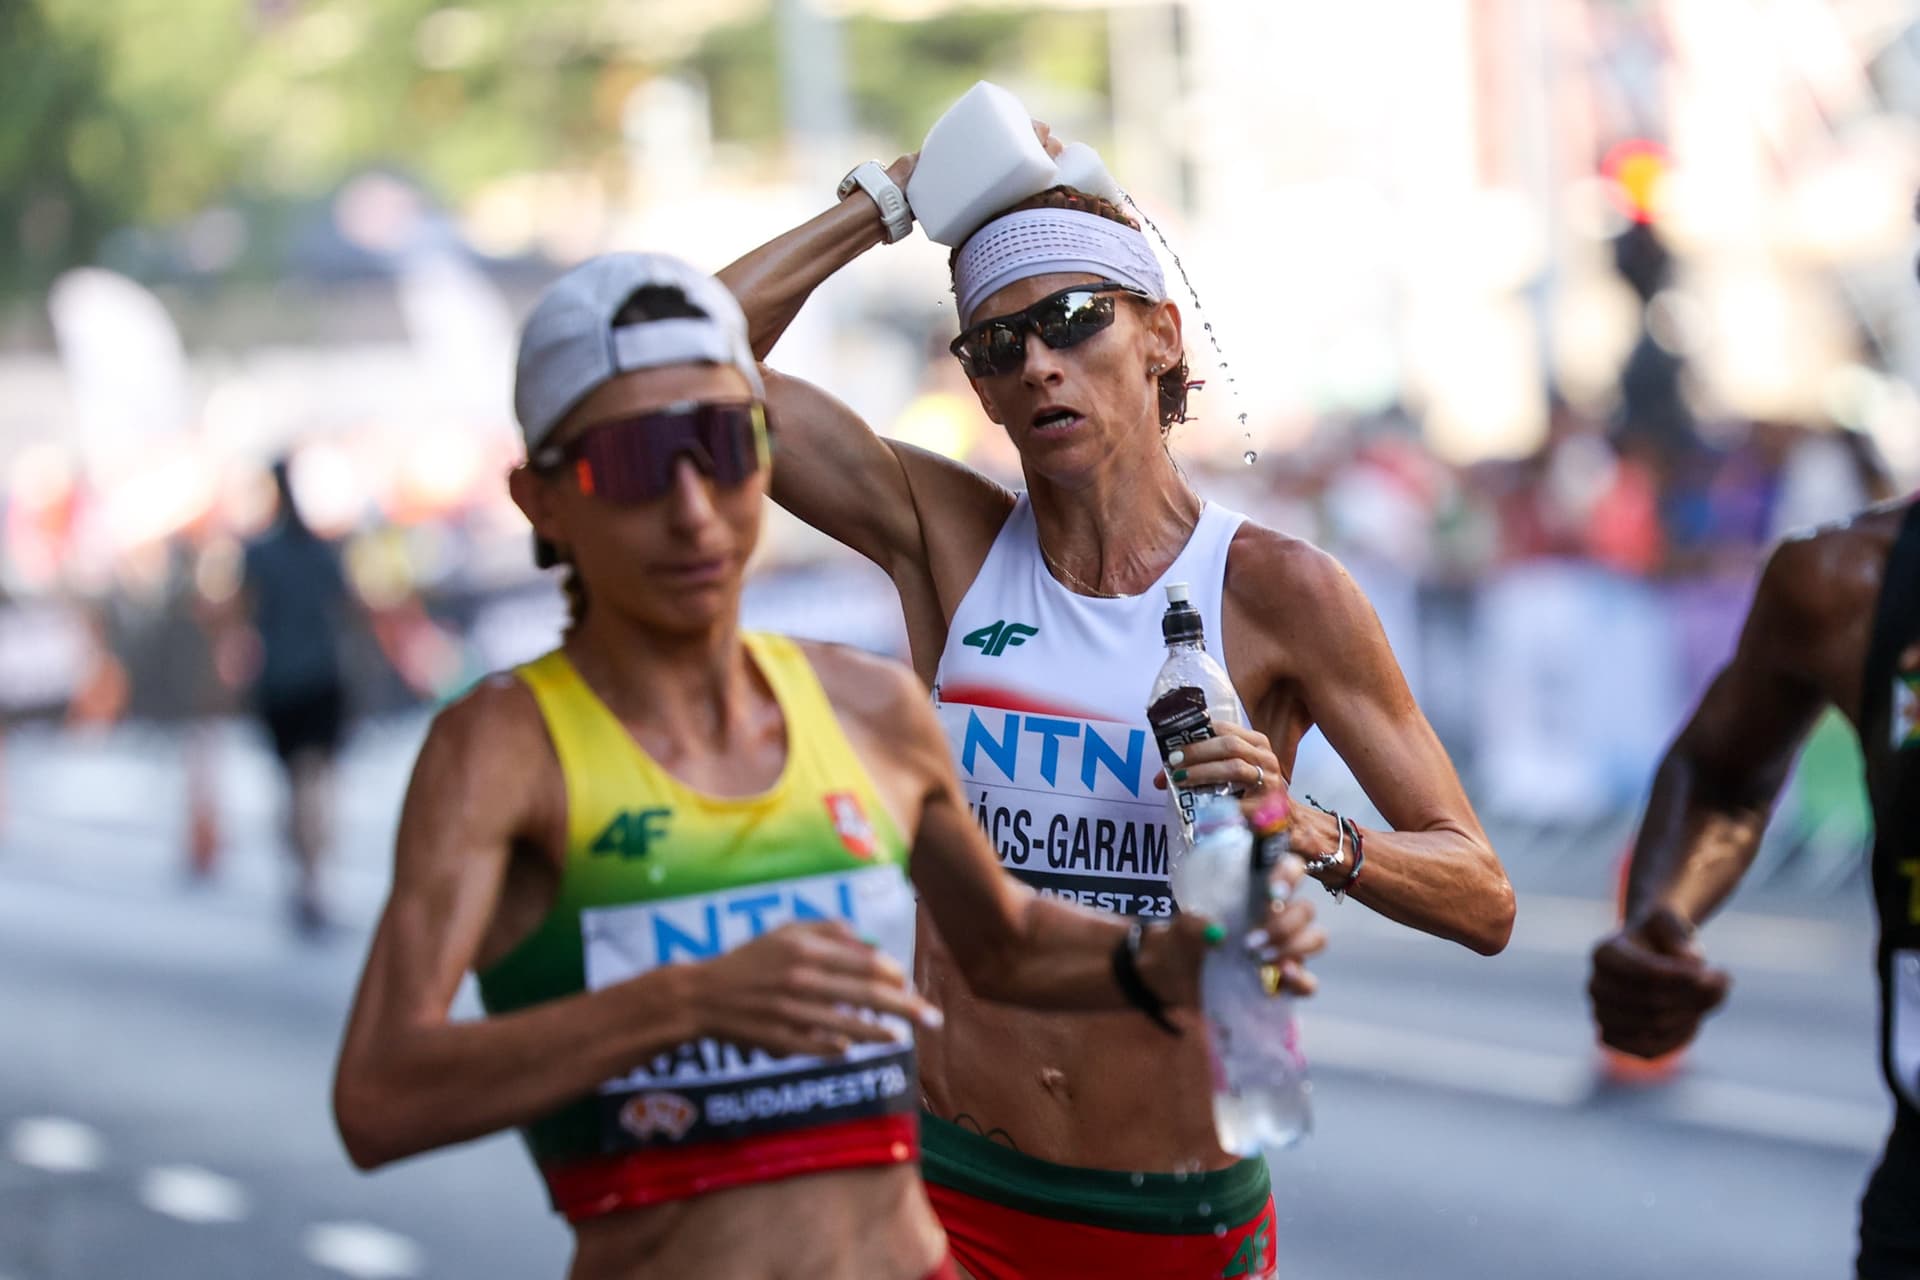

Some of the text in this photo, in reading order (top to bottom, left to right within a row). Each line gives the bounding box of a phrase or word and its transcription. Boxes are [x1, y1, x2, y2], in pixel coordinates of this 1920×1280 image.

[963, 619, 1039, 656] 4F
[961, 708, 1146, 799] NTN
[591, 808, 671, 859] 4F
[967, 791, 1169, 875] ÁCS-GARAM
[1137, 895, 1172, 917] 23
